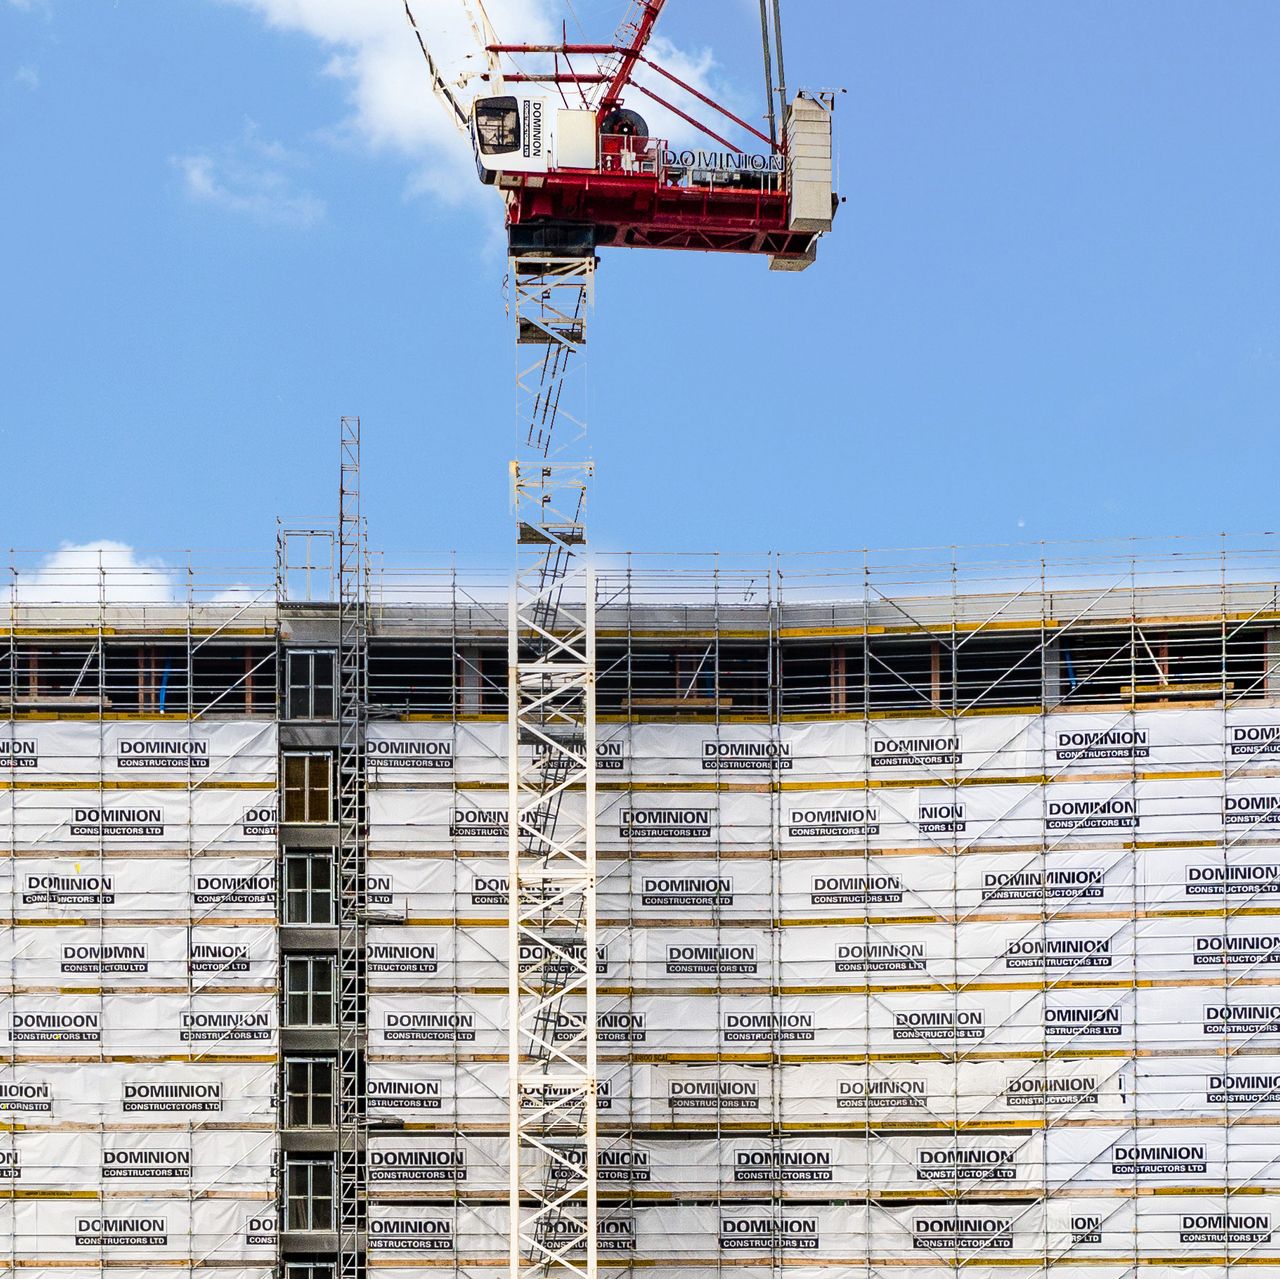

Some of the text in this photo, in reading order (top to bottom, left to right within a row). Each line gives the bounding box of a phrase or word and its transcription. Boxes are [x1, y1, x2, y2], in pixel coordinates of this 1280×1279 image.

[533, 102, 541, 156] DOMINION
[662, 150, 784, 171] DOMINION
[1059, 731, 1146, 746] DOMINION
[75, 809, 161, 822] DOMINION
[646, 879, 730, 892] DOMINION
[815, 877, 899, 890] DOMINION
[670, 947, 754, 959] DOMINION
[387, 1014, 472, 1027] DOMINION
[104, 1151, 189, 1164] DOMINION
[1116, 1147, 1203, 1160] DOMINION
[79, 1219, 164, 1232] DOMINION
[1183, 1216, 1268, 1229] DOMINION
